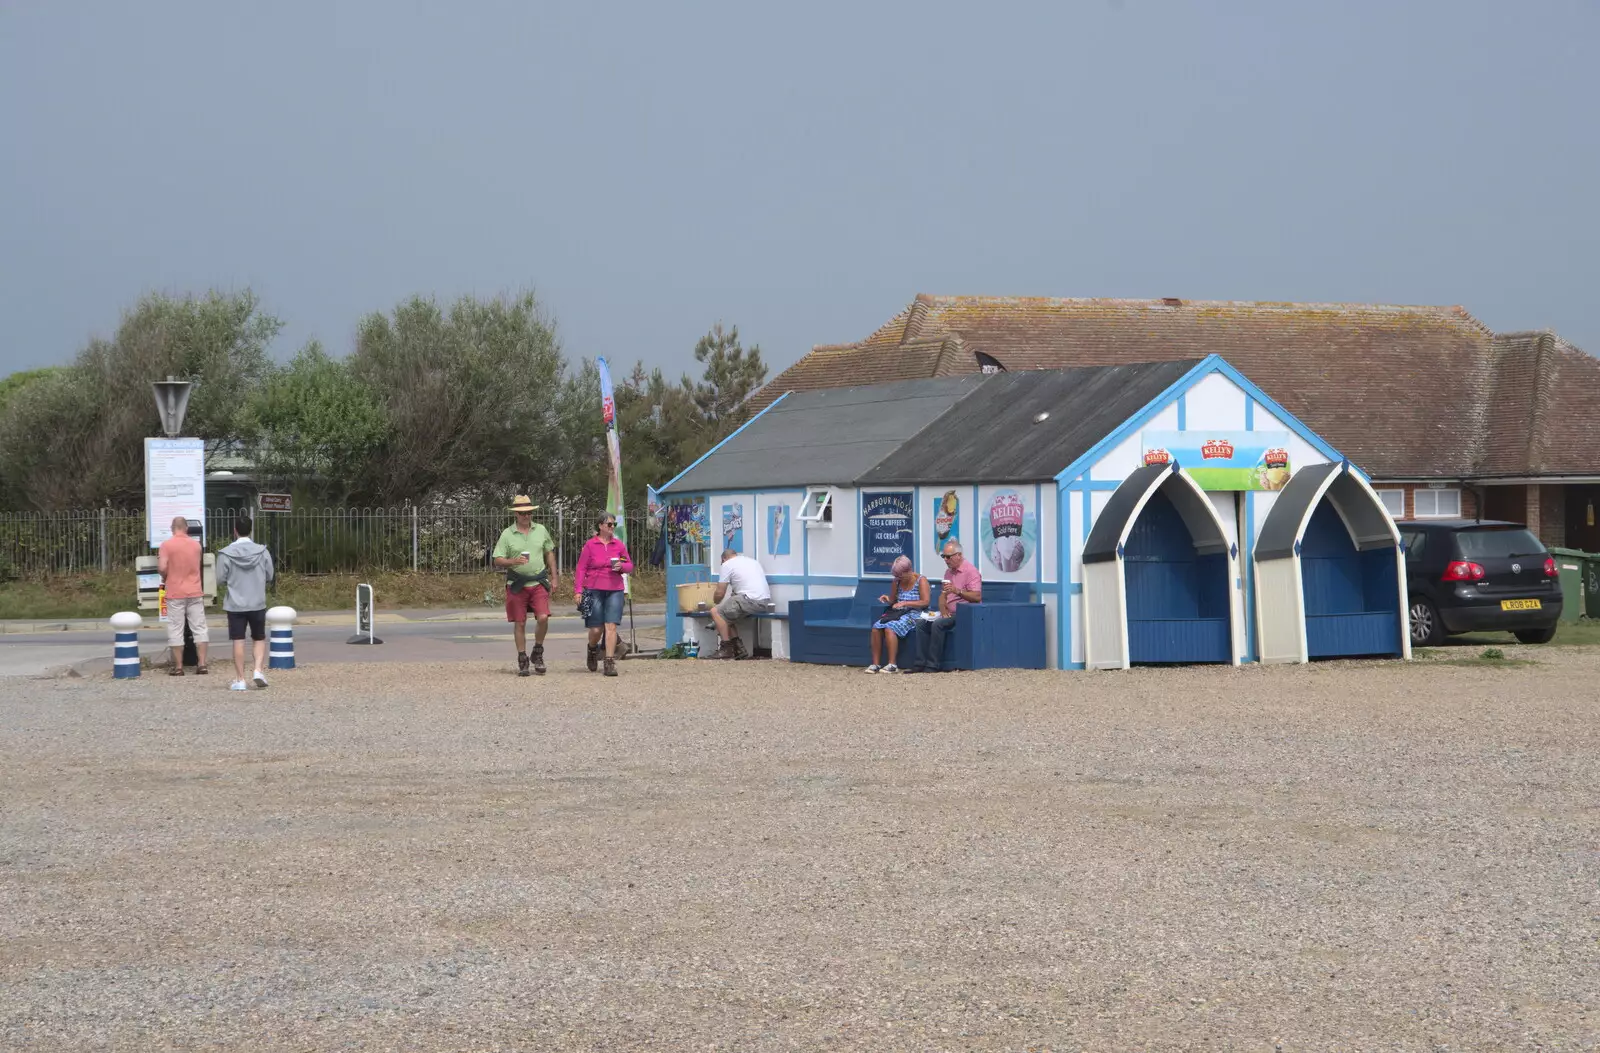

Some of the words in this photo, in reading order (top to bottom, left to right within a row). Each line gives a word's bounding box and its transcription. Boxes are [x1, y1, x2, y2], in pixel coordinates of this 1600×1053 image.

[1203, 446, 1232, 455] KELLY'S
[1146, 453, 1168, 461] KELLY'S
[1266, 453, 1287, 461] KELLY'S
[862, 496, 892, 516] HARBOUR
[893, 497, 913, 516] KIOSK
[992, 505, 1021, 520] KELLY'S
[997, 527, 1007, 535] Sold
[875, 532, 883, 540] ICE
[883, 532, 900, 540] CREAM
[873, 546, 903, 554] SANDWICHES
